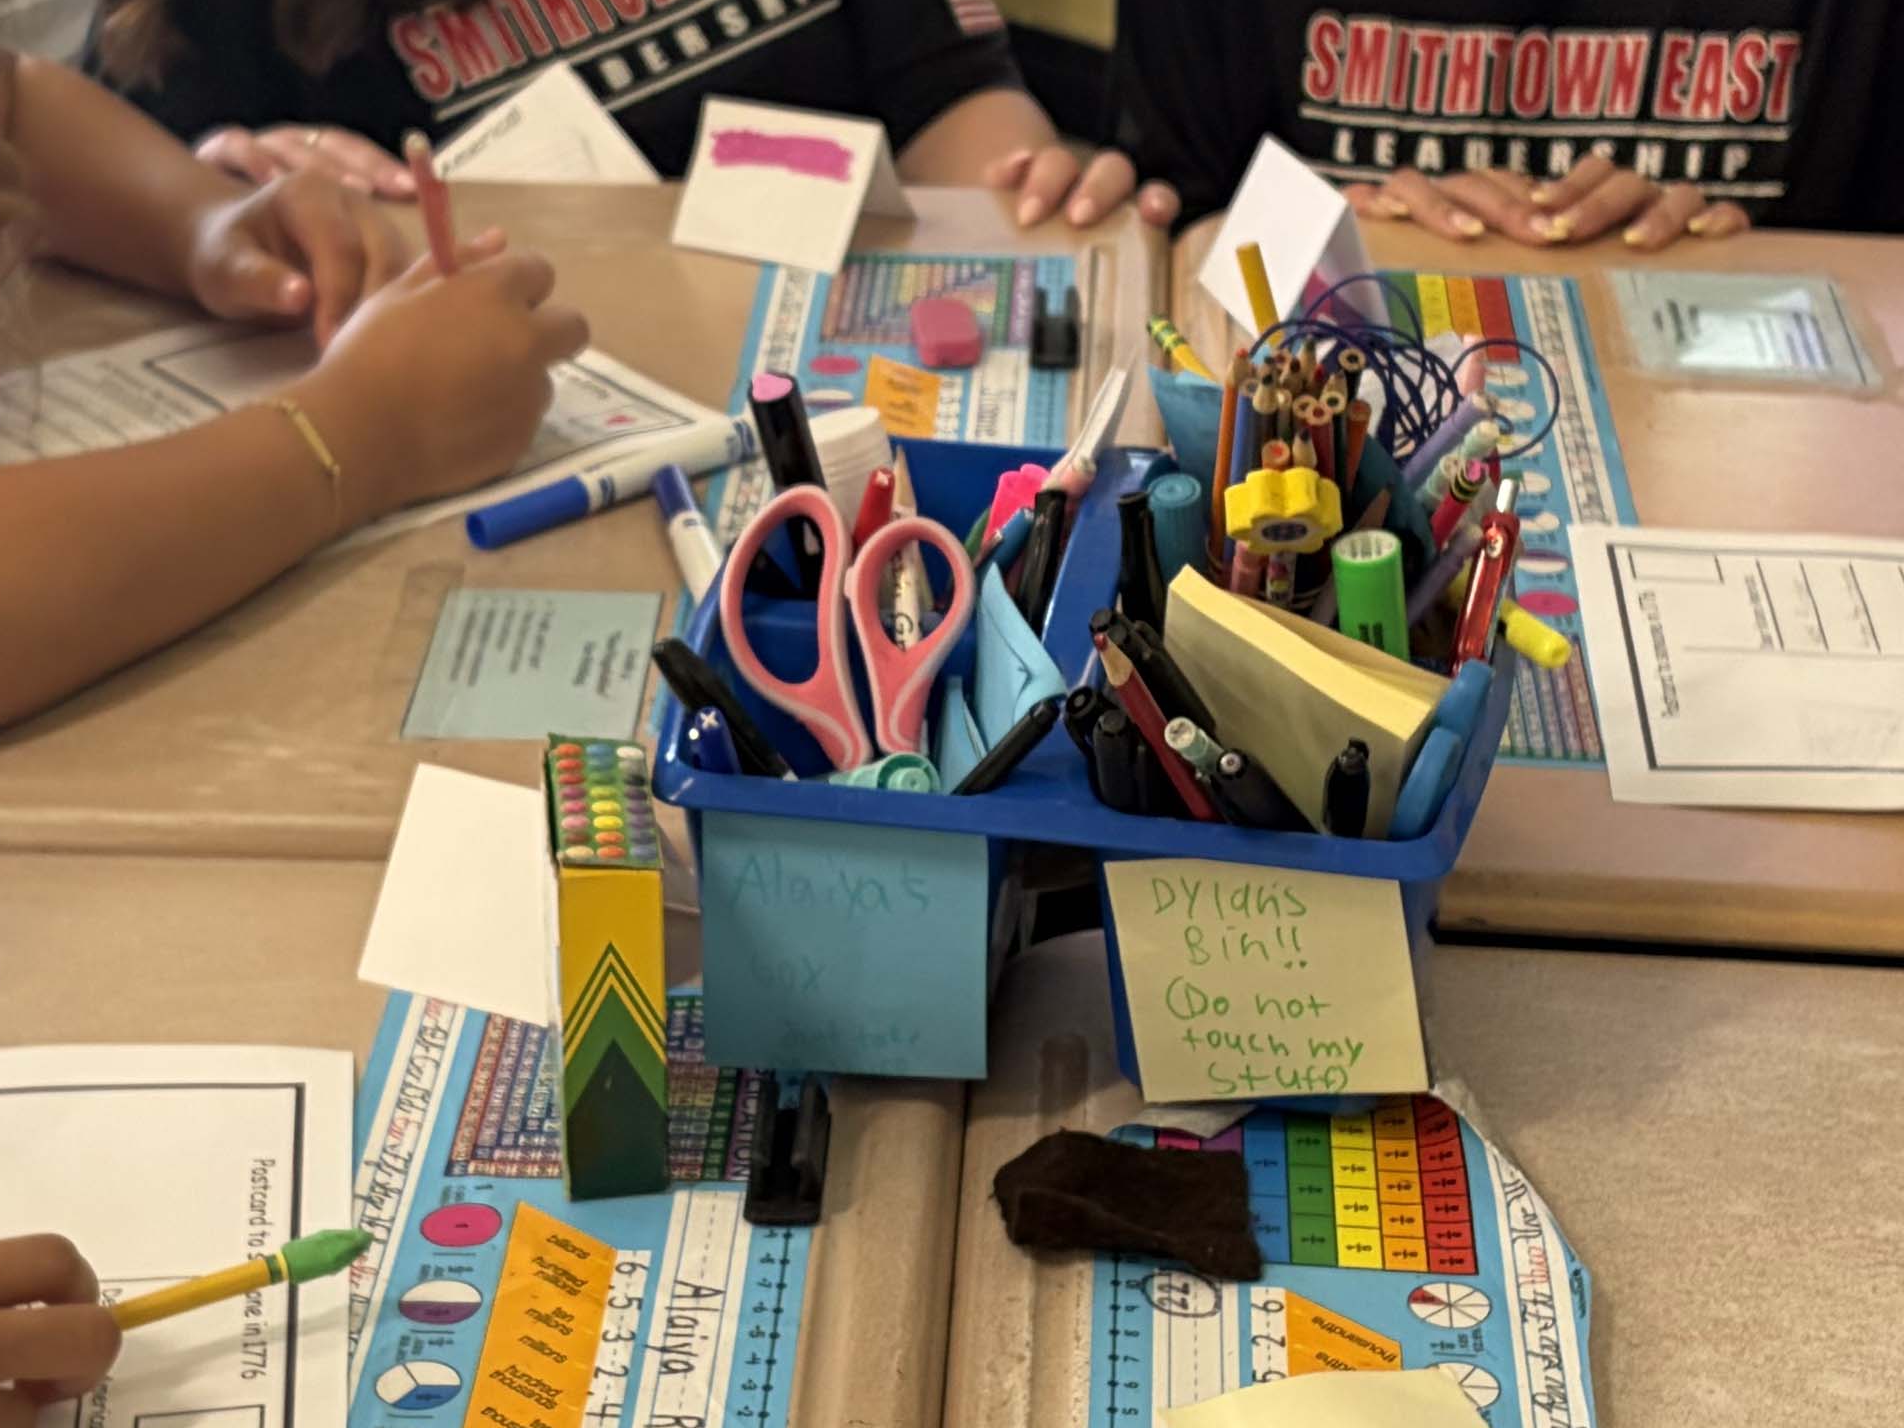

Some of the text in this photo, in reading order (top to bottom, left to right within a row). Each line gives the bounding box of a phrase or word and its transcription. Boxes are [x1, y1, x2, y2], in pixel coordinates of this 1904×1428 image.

[1302, 12, 1801, 123] SMITHTOWN EAST
[1182, 1027, 1364, 1068] touch my
[1255, 993, 1332, 1021] not
[240, 1158, 276, 1381] Postcard to sone in 1776
[644, 1279, 725, 1375] Alaiya
